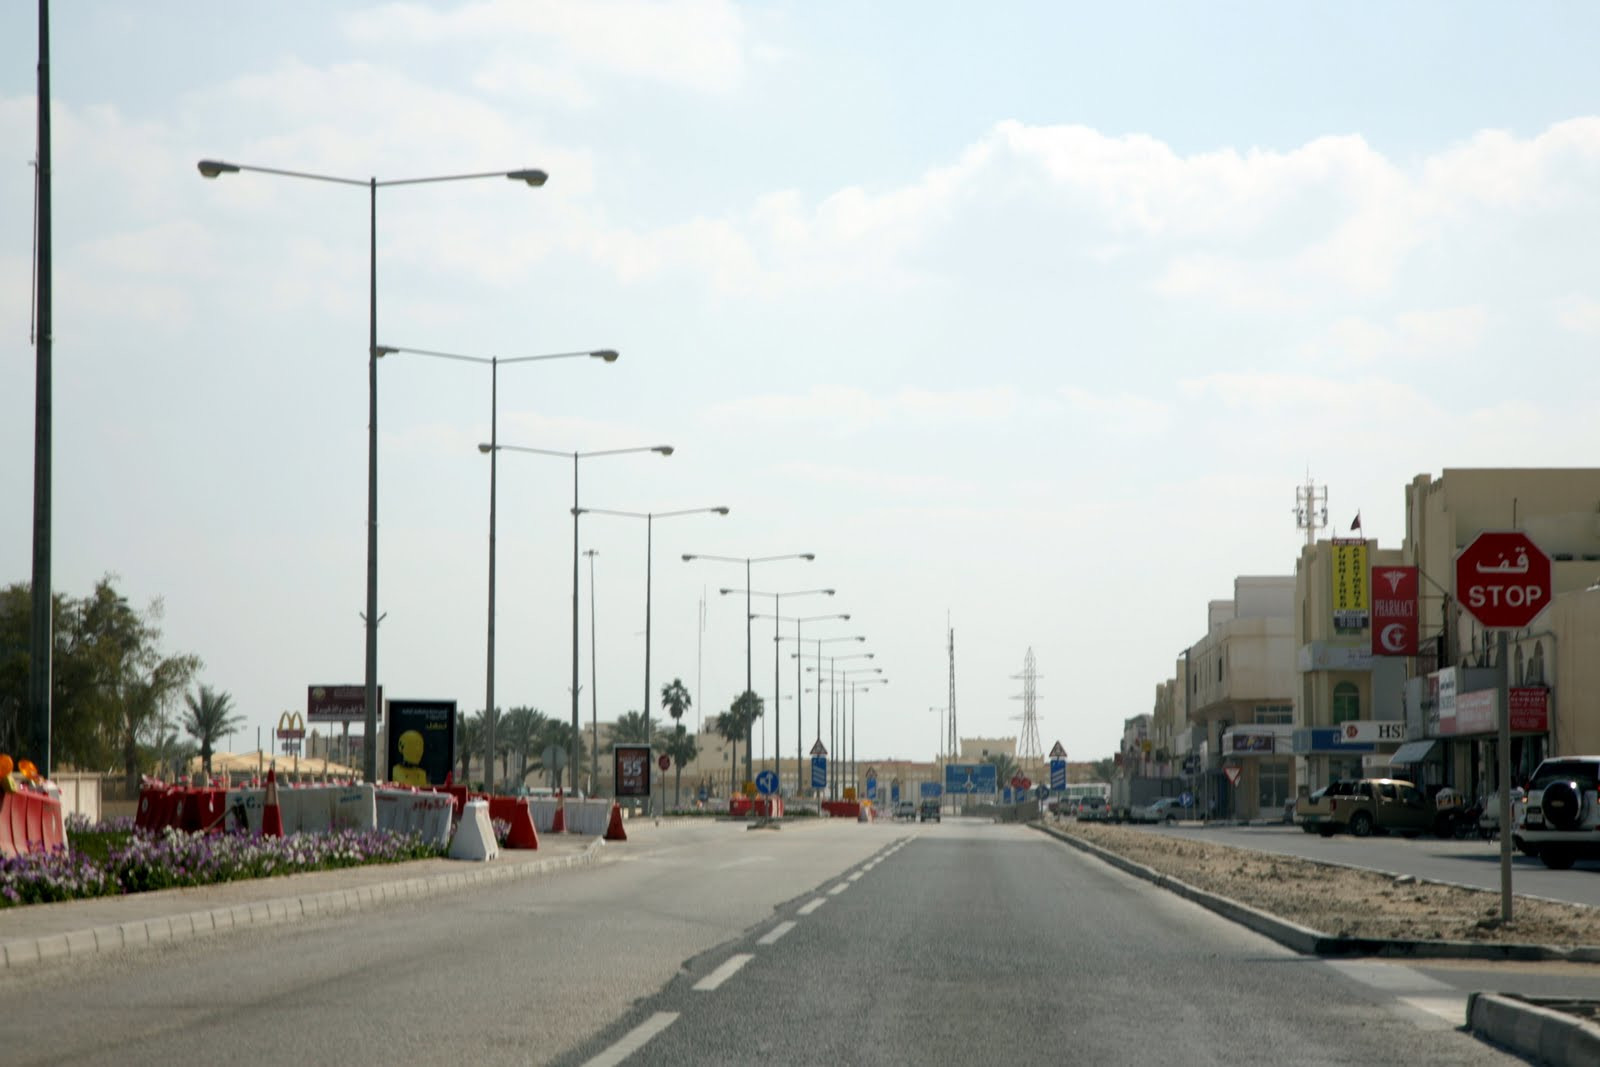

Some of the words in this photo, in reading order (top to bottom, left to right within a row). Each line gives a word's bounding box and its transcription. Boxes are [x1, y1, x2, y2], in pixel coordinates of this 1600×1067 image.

[1476, 546, 1530, 573] قف
[1338, 547, 1347, 607] FURNISHED
[1352, 547, 1361, 607] APARTMENTS
[1374, 599, 1415, 617] PHARMACY
[1468, 585, 1542, 607] STOP
[1378, 724, 1404, 738] HS
